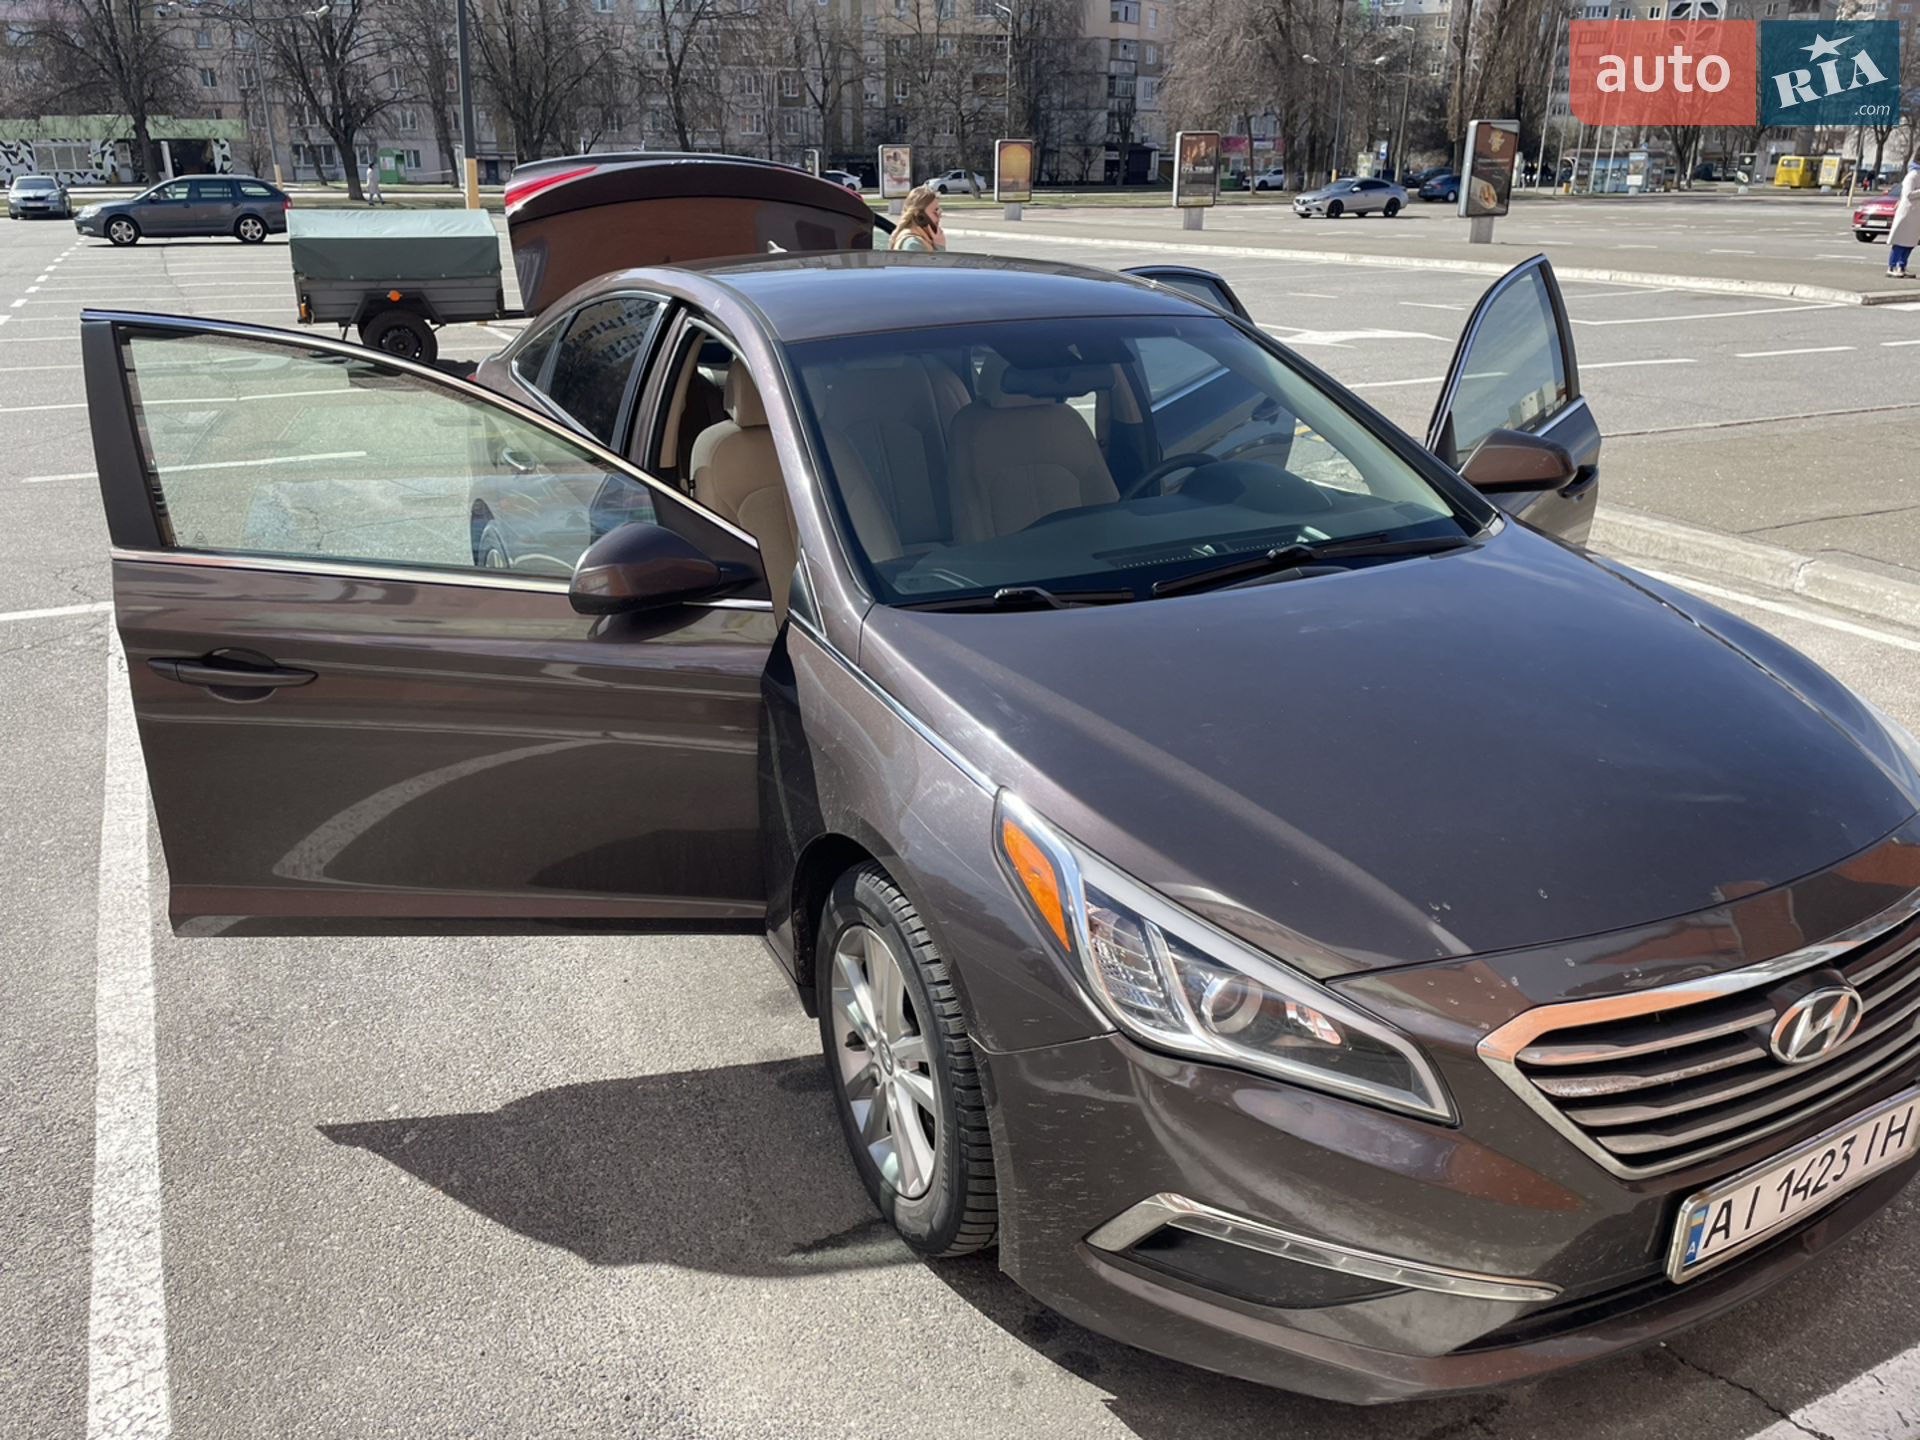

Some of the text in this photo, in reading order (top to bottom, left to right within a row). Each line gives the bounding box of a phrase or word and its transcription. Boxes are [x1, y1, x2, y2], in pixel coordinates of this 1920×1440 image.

[1703, 1105, 1914, 1250] AI 1423 IH
